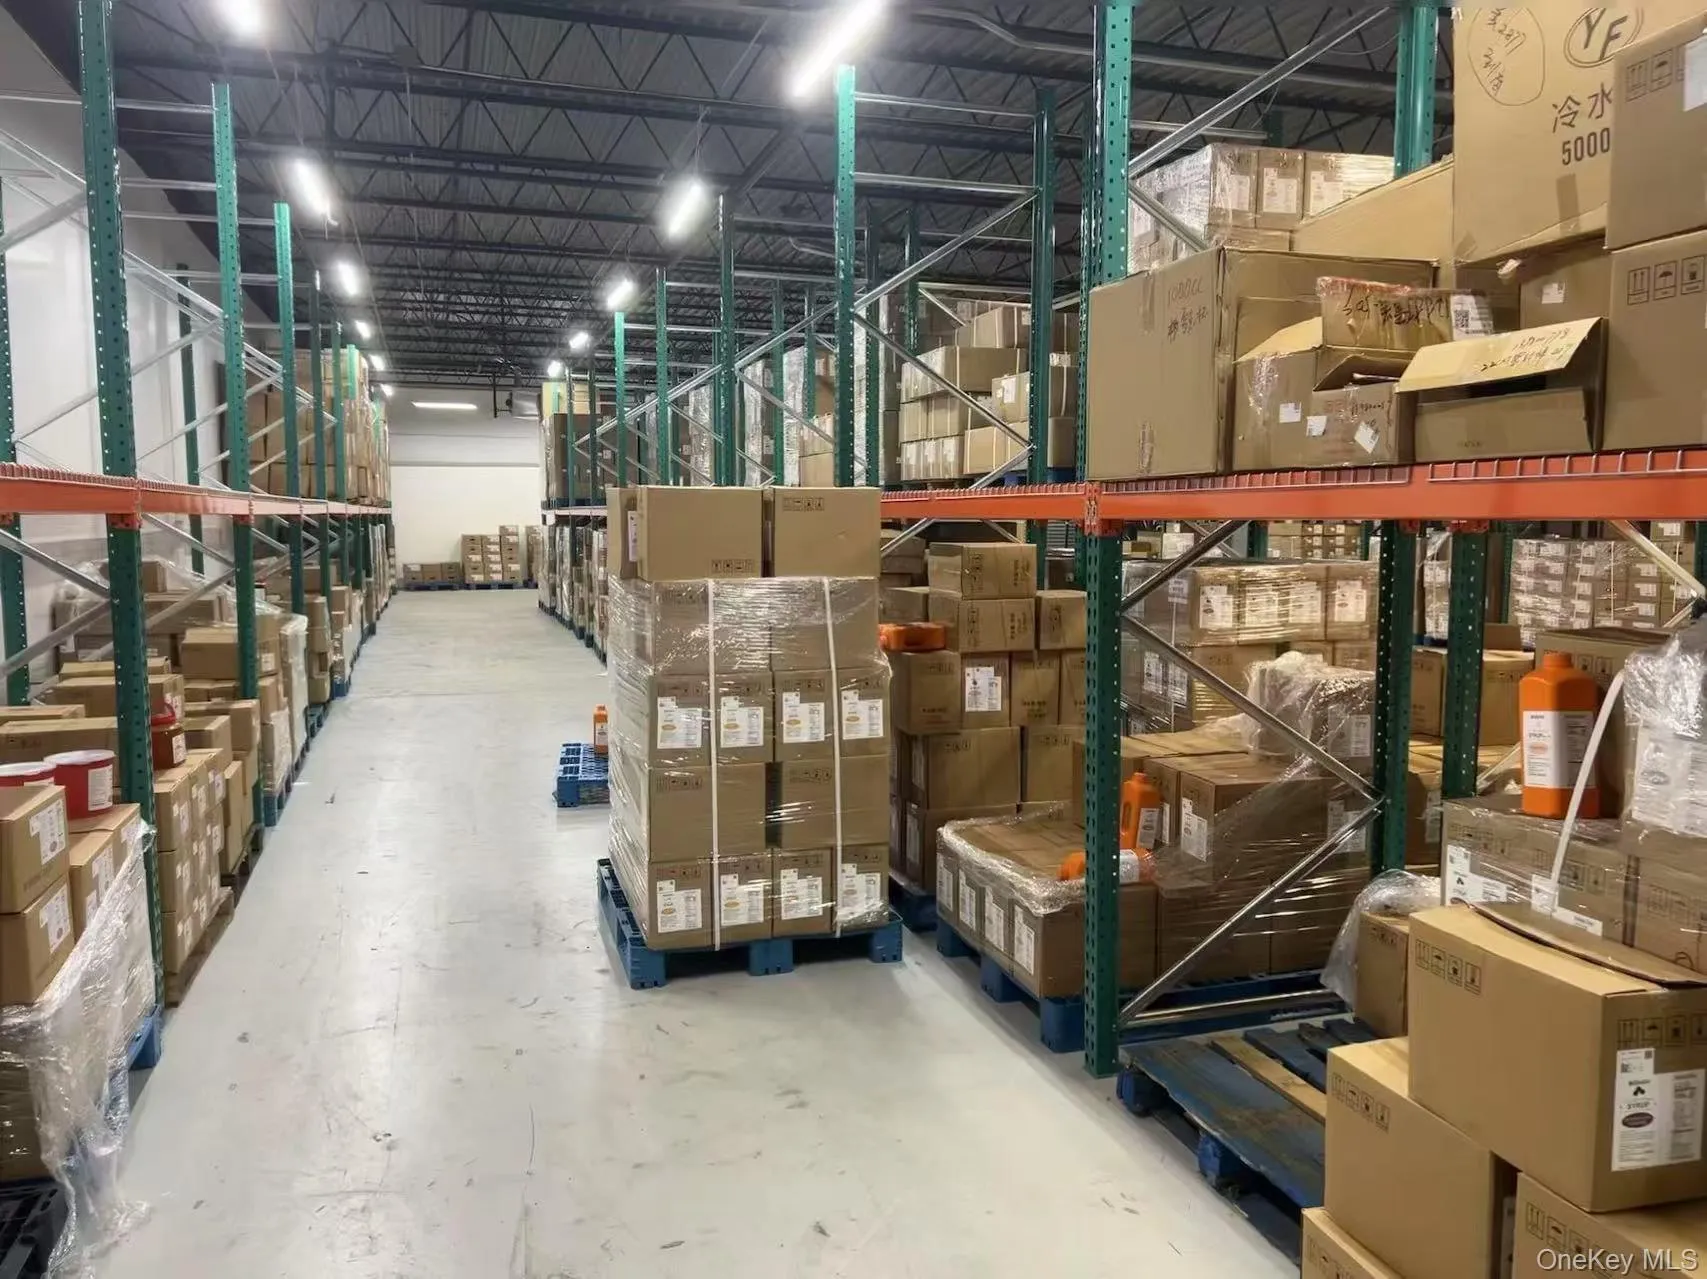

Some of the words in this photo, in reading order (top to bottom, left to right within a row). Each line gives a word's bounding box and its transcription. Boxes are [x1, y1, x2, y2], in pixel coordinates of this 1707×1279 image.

[1583, 8, 1629, 62] YF
[1551, 83, 1614, 134] 冷水
[1561, 128, 1611, 167] 5000
